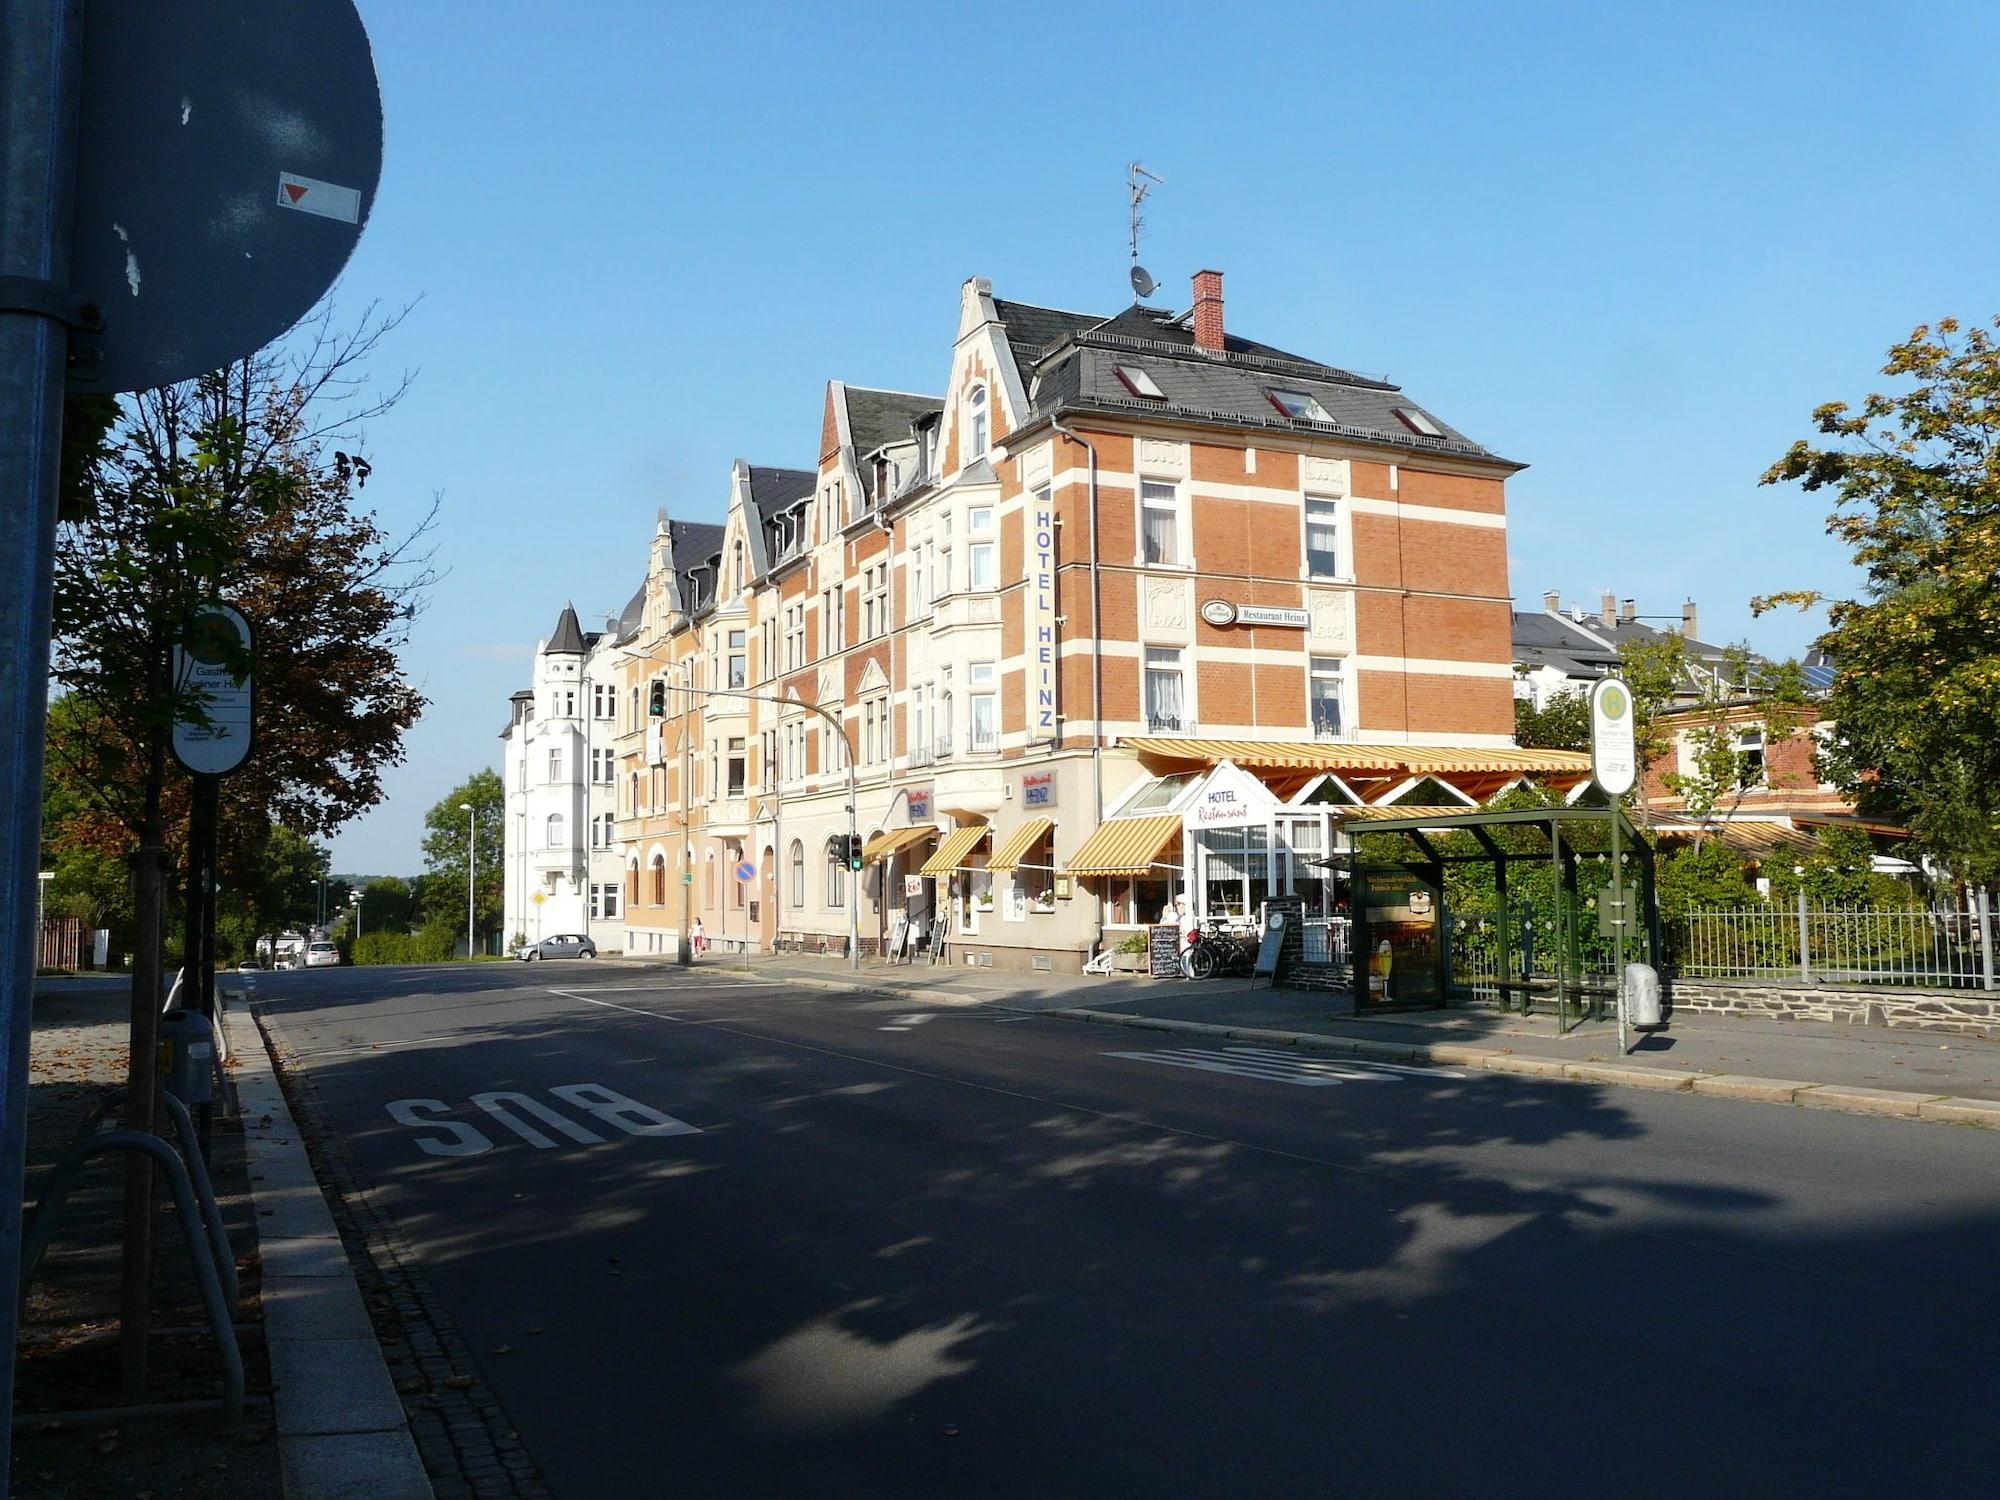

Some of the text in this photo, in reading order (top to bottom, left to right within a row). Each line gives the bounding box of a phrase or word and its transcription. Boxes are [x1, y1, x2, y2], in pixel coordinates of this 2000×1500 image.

[1037, 511, 1052, 726] HOTEL HEINZ
[1243, 609, 1283, 621] Restaurant
[1284, 611, 1305, 622] Heinz
[1208, 790, 1237, 803] HOTEL
[384, 1083, 704, 1156] BUS
